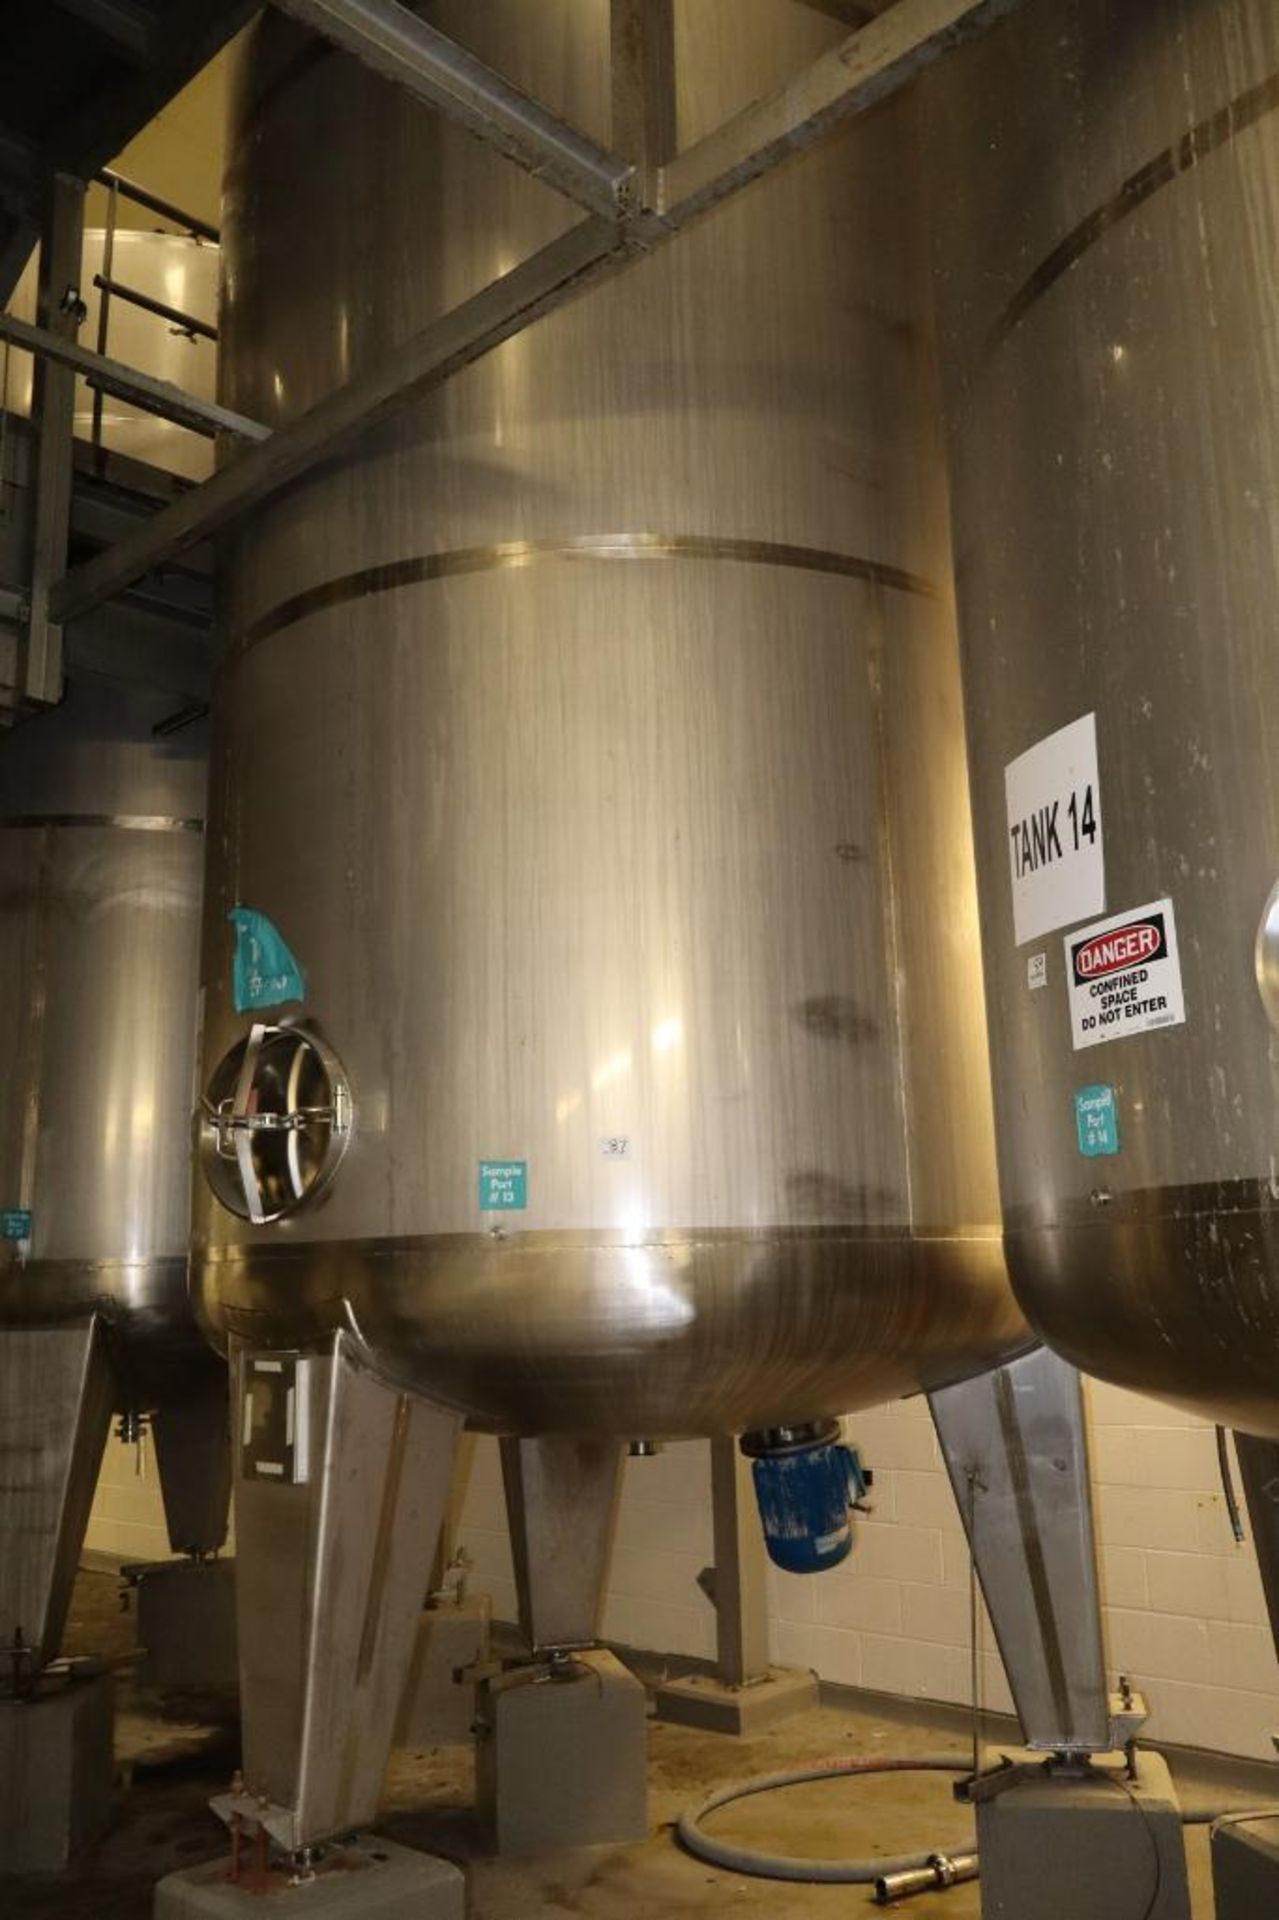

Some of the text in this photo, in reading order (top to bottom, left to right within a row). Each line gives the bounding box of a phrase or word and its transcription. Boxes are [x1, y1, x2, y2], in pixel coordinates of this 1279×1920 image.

[1010, 783, 1097, 880] TANK 14
[1077, 928, 1154, 974] DANGER
[1089, 969, 1149, 998] CONFINED
[1100, 987, 1138, 1010] SPACE
[1081, 996, 1168, 1031] DO NOT ENTER
[482, 1165, 522, 1179] Sample
[490, 1179, 512, 1190] Port
